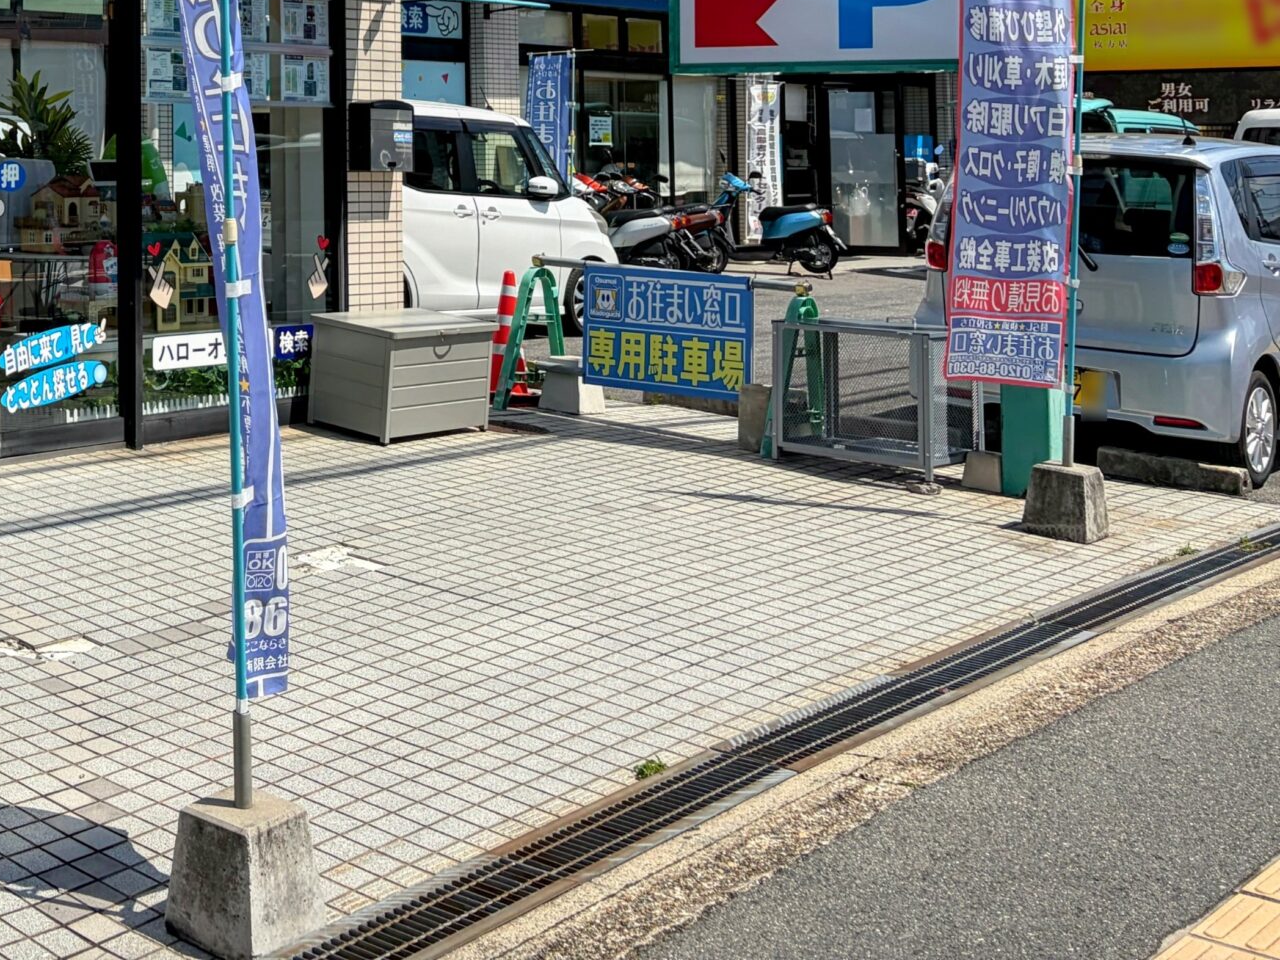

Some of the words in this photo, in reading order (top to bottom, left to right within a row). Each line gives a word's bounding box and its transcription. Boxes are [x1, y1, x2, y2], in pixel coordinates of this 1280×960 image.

[1161, 82, 1192, 97] 男女
[1148, 98, 1210, 113] ご利用可
[1, 163, 20, 190] 押
[628, 280, 740, 329] お住まい窓口
[4, 330, 63, 376] 自由に来て
[70, 323, 94, 354] 見て
[279, 330, 310, 354] 検索
[588, 328, 744, 391] 専用駐車場
[6, 363, 89, 414] とことん探せる
[248, 559, 275, 571] OK
